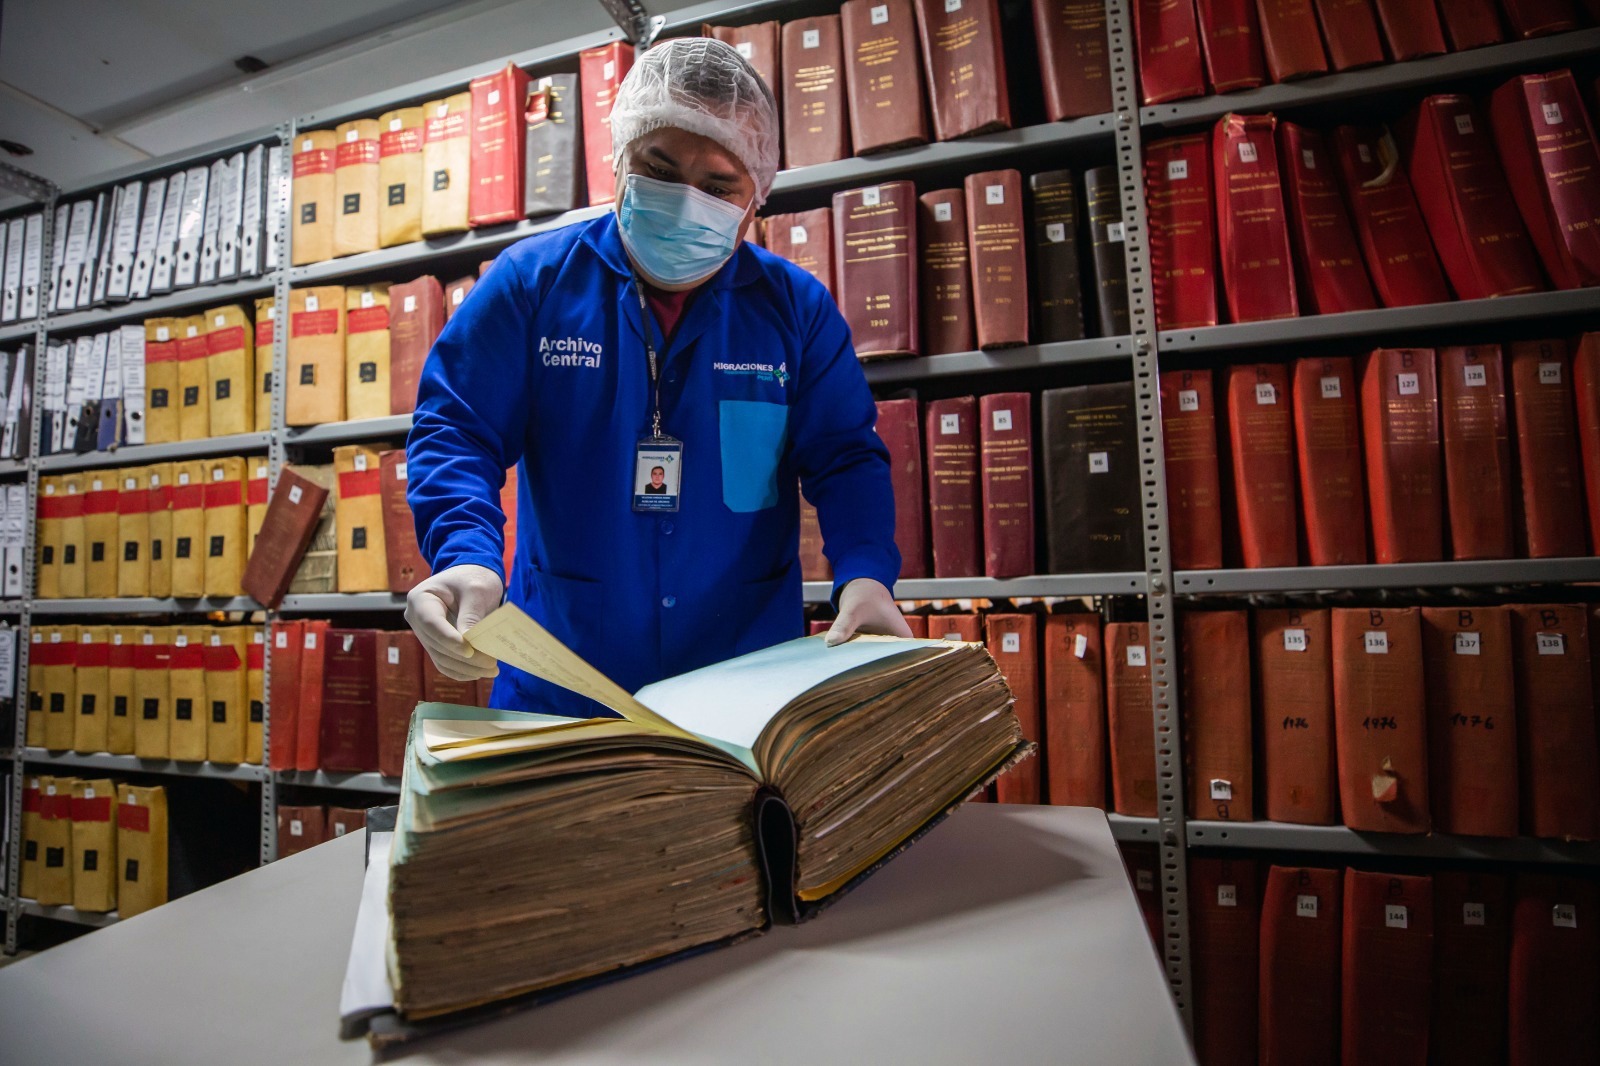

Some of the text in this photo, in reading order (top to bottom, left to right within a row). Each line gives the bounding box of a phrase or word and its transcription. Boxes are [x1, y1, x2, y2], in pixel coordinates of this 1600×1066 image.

[539, 336, 602, 354] Archivo
[542, 352, 601, 368] Central
[1402, 351, 1413, 368] B
[713, 362, 774, 371] MIGRACIONES
[1467, 372, 1482, 380] 128
[1542, 370, 1557, 378] 129
[1182, 397, 1195, 405] 124
[1288, 610, 1302, 626] B
[1369, 610, 1384, 627] B
[1458, 610, 1474, 627] B
[1540, 609, 1559, 627] B
[1128, 625, 1139, 642] B
[1287, 636, 1303, 644] 135
[1368, 639, 1385, 647] 136
[1459, 640, 1476, 648] 137
[1541, 640, 1560, 648] 138
[1363, 716, 1397, 730] 1976
[1451, 713, 1494, 730] 1976
[1388, 878, 1403, 896] B
[1389, 912, 1404, 920] 144
[1466, 910, 1482, 918] 145
[1555, 911, 1573, 920] 146
